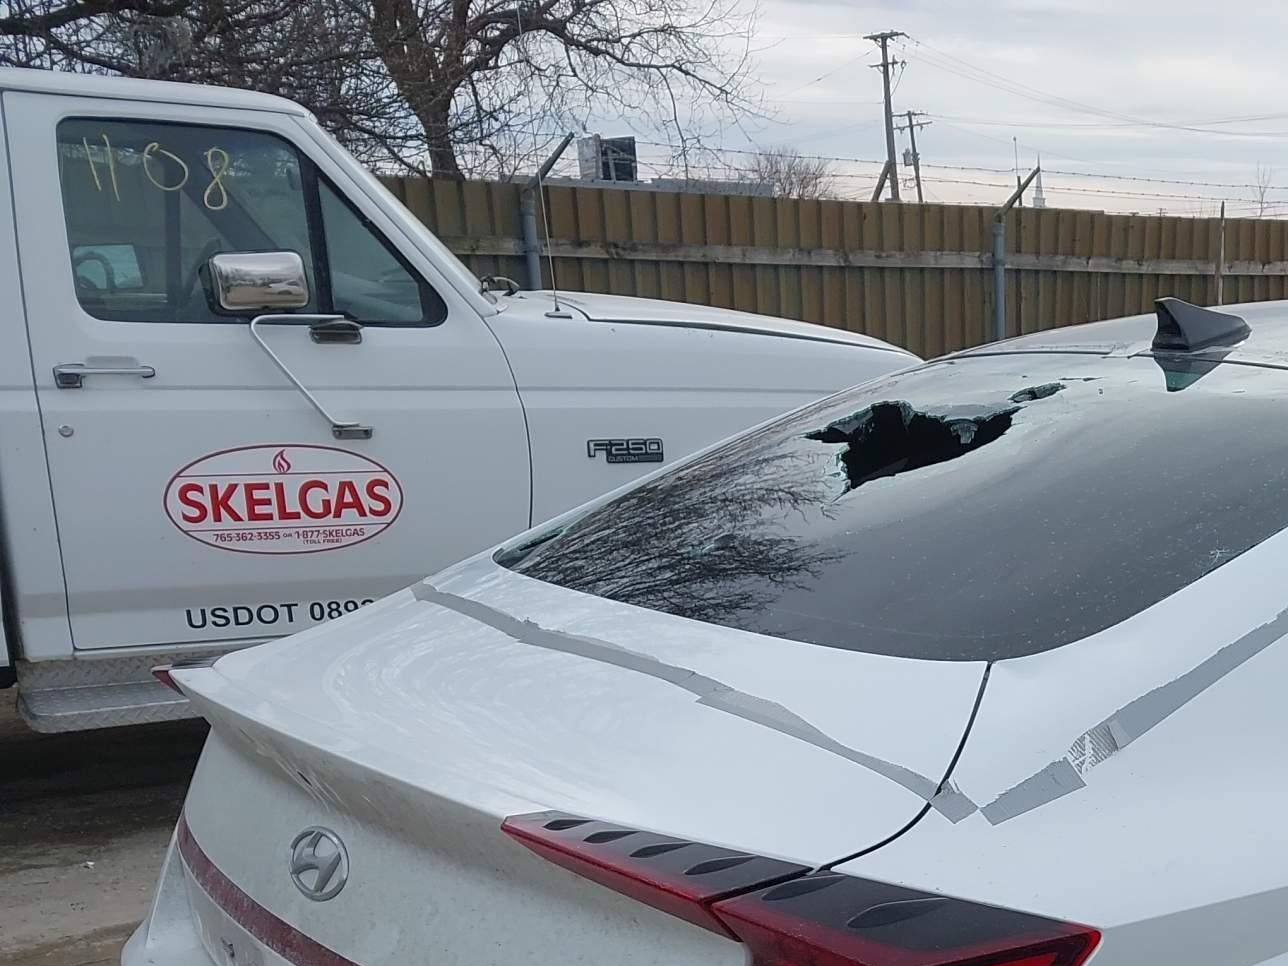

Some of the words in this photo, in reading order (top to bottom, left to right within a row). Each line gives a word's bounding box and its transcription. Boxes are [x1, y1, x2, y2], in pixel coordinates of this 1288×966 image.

[587, 438, 664, 458] F250
[178, 479, 392, 524] SKELGAS
[186, 602, 299, 629] USDOT
[309, 599, 376, 622] 089
